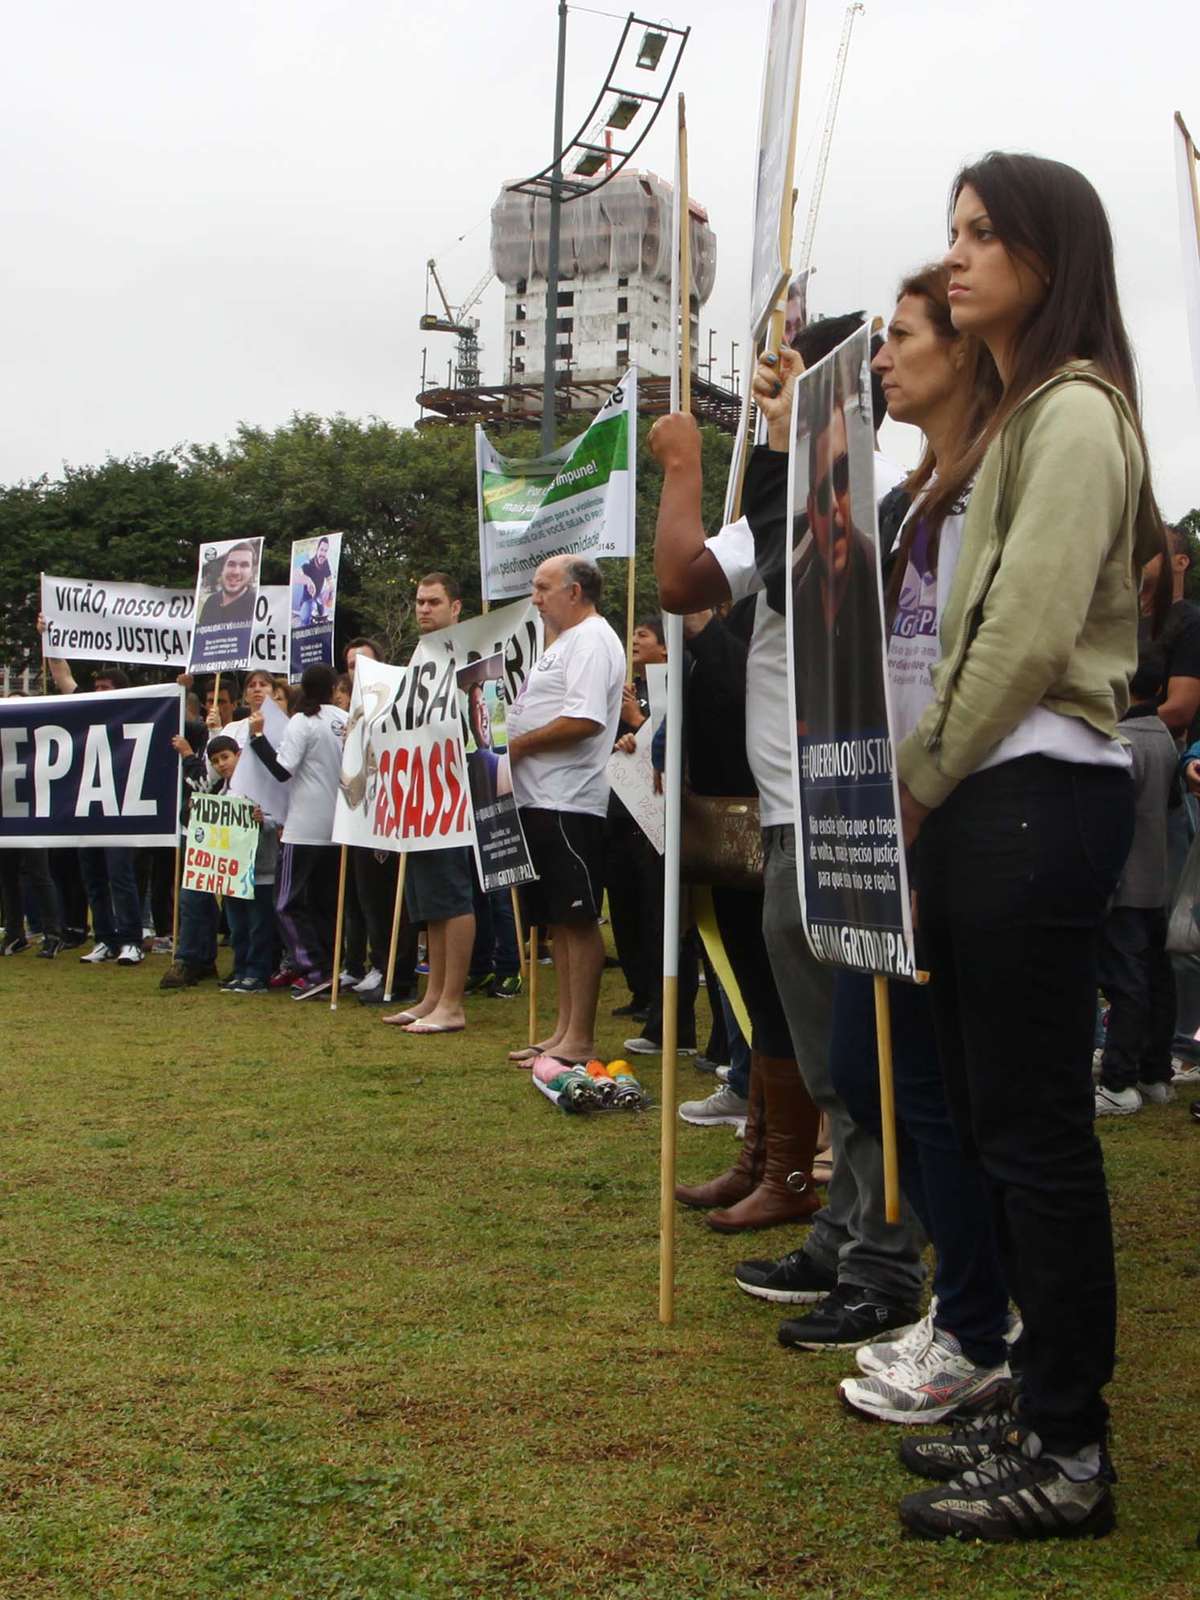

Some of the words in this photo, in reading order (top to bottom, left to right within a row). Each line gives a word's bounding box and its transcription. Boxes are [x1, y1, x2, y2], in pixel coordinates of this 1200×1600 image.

[555, 462, 598, 487] impune!
[55, 583, 107, 618] VITÃO,
[112, 597, 165, 618] nosso
[47, 620, 112, 651] faremos
[116, 626, 183, 661] JUSTIÇA
[853, 819, 868, 838] que
[868, 819, 875, 835] o
[876, 816, 897, 839] traga
[873, 841, 899, 867] justiça
[185, 870, 235, 896] PENAL
[817, 871, 831, 889] para
[863, 873, 873, 890] se
[873, 870, 896, 894] repita
